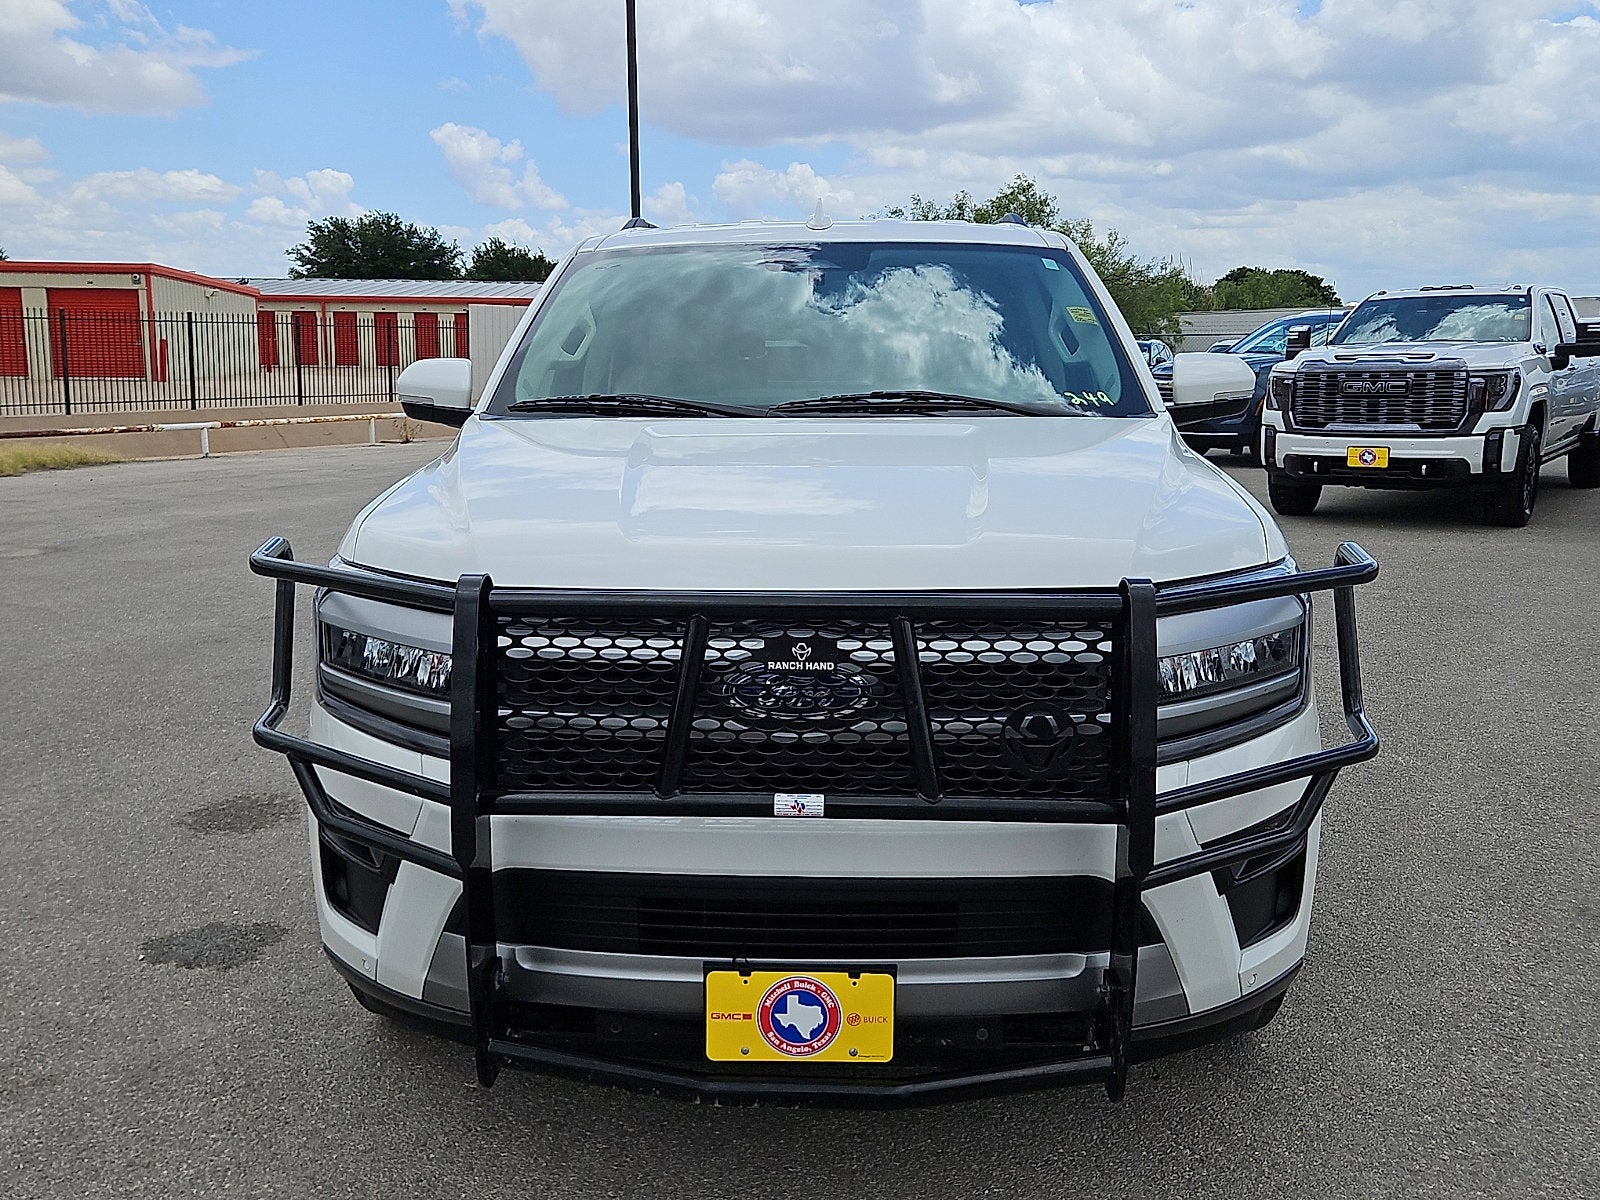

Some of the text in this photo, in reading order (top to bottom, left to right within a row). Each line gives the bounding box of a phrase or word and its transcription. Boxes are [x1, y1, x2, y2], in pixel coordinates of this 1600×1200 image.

[1343, 381, 1406, 393] GMC
[767, 661, 835, 671] RANCH HAND
[764, 980, 835, 1009] Mitchell Buick GMC
[710, 1012, 742, 1021] GMC
[863, 1015, 889, 1024] BUICK
[767, 1031, 832, 1054] San Angelo, Texas
